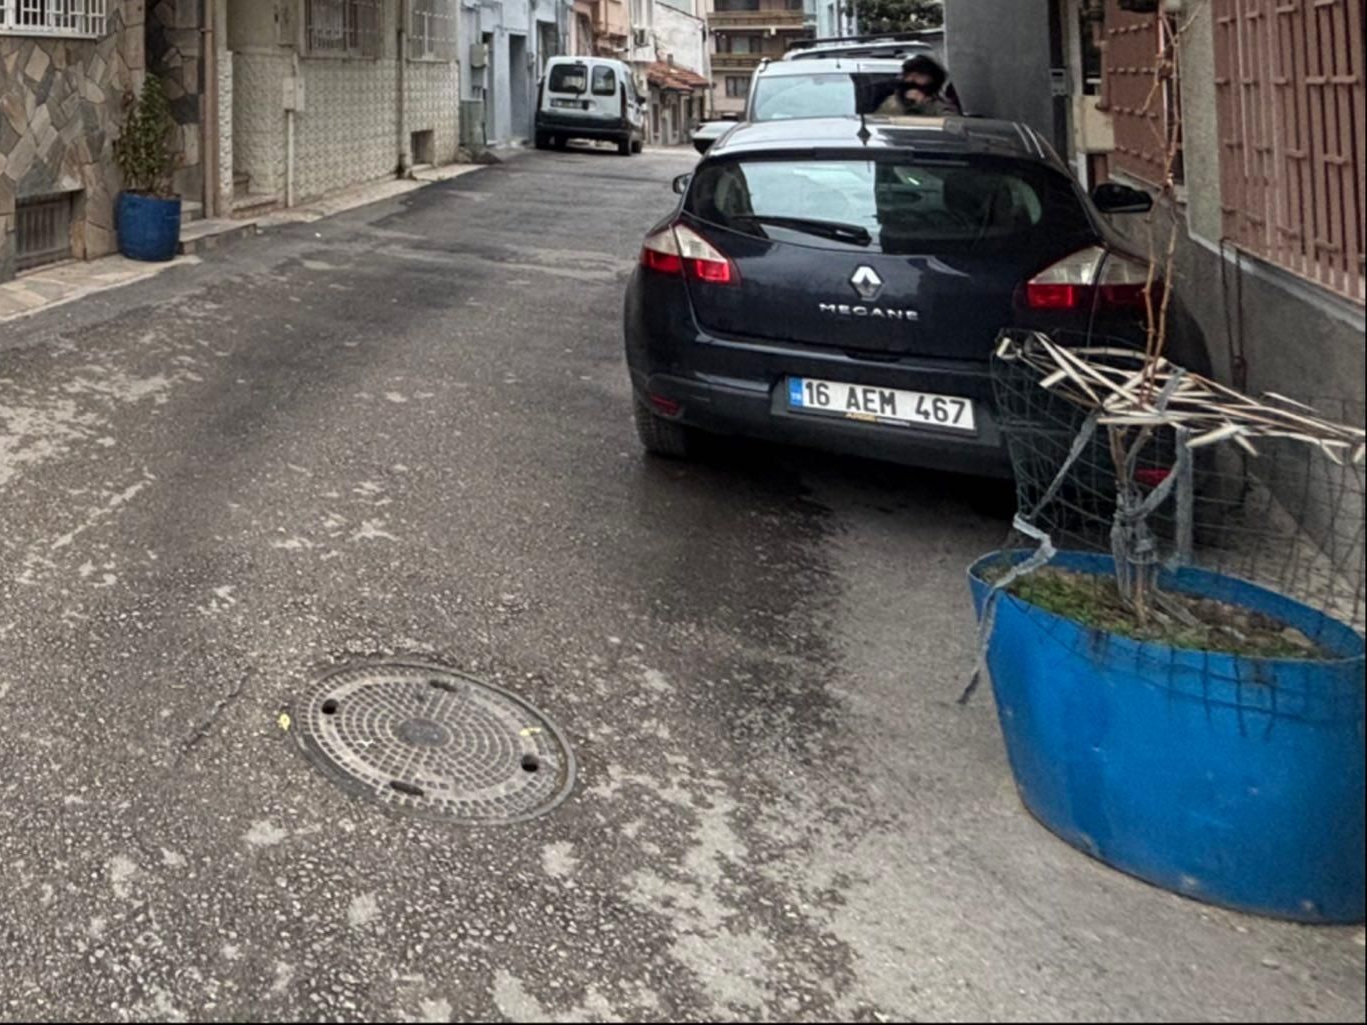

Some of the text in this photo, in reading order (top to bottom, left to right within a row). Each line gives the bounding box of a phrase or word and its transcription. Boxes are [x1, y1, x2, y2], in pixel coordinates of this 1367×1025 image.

[805, 381, 830, 407] 16
[846, 386, 897, 416] AEM
[915, 395, 966, 424] 467
